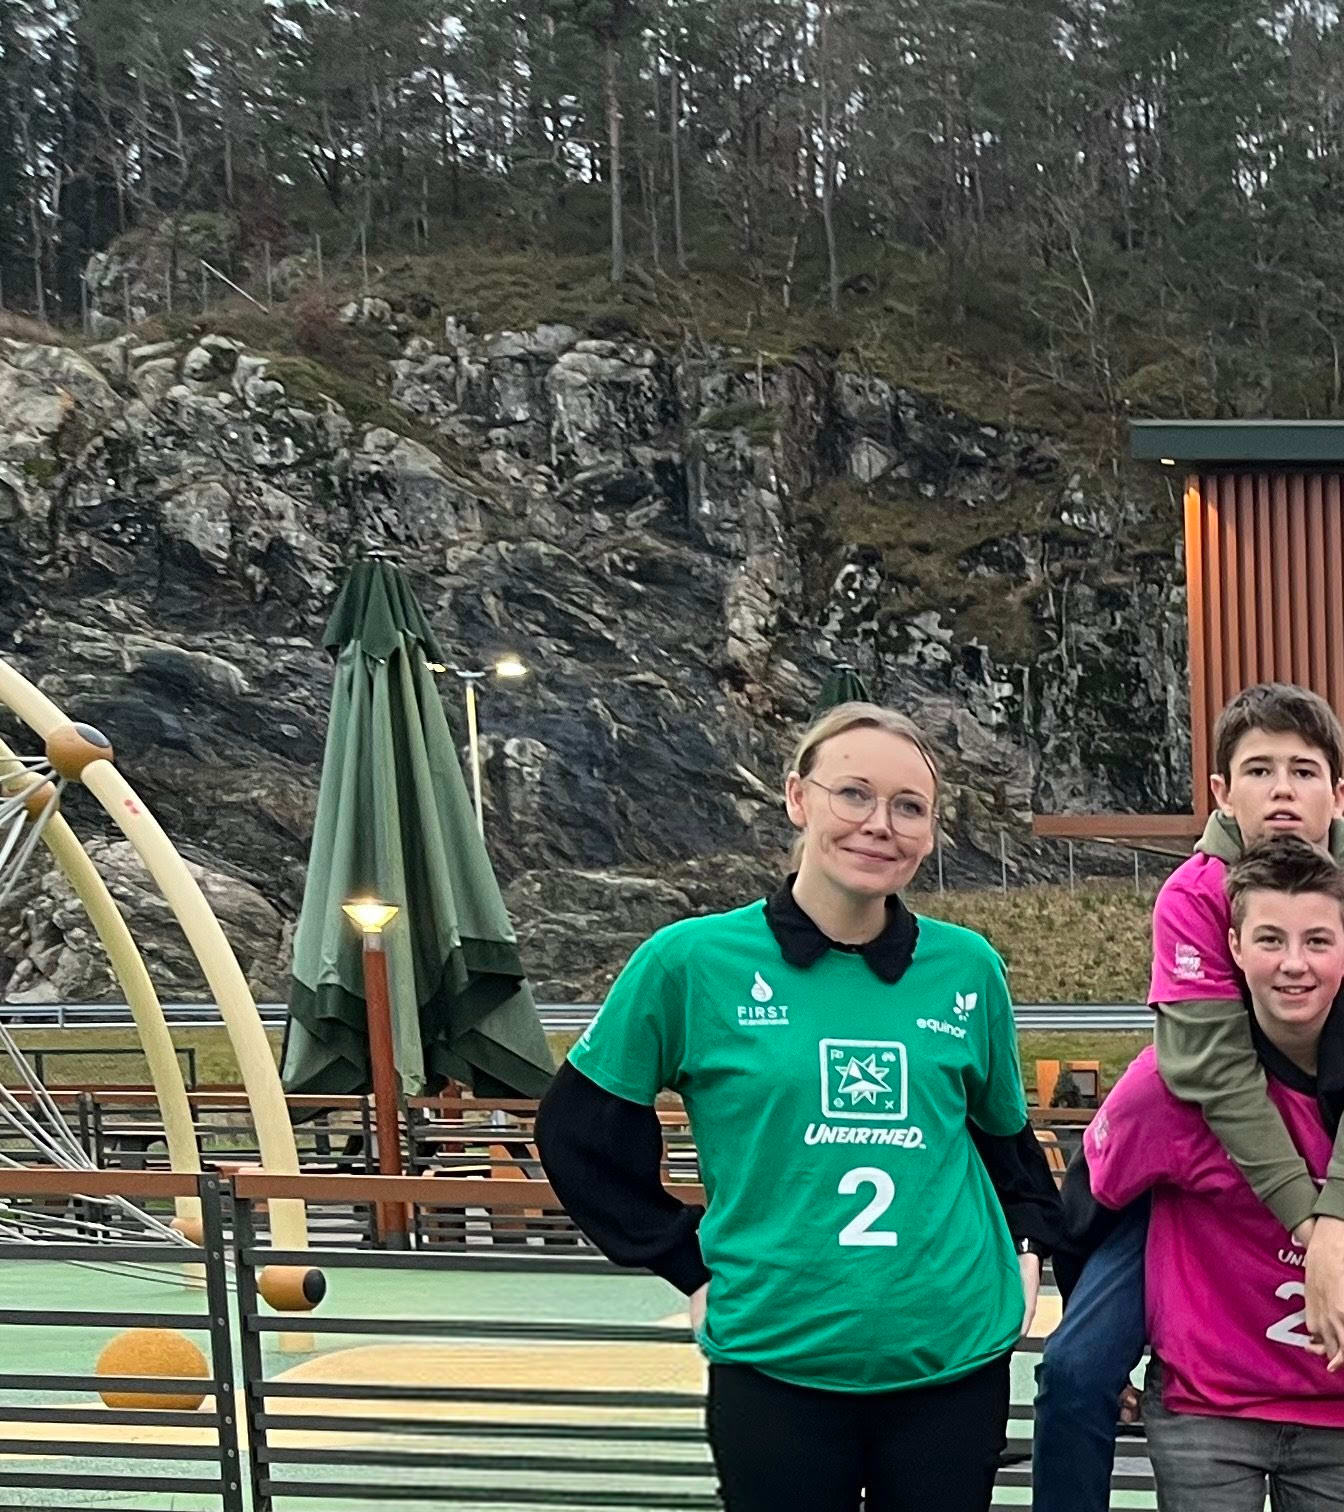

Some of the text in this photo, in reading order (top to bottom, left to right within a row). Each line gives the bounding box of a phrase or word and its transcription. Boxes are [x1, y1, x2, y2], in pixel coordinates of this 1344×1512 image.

[737, 1006, 789, 1019] FIRST
[916, 1018, 967, 1039] equinor
[838, 1167, 898, 1247] 2
